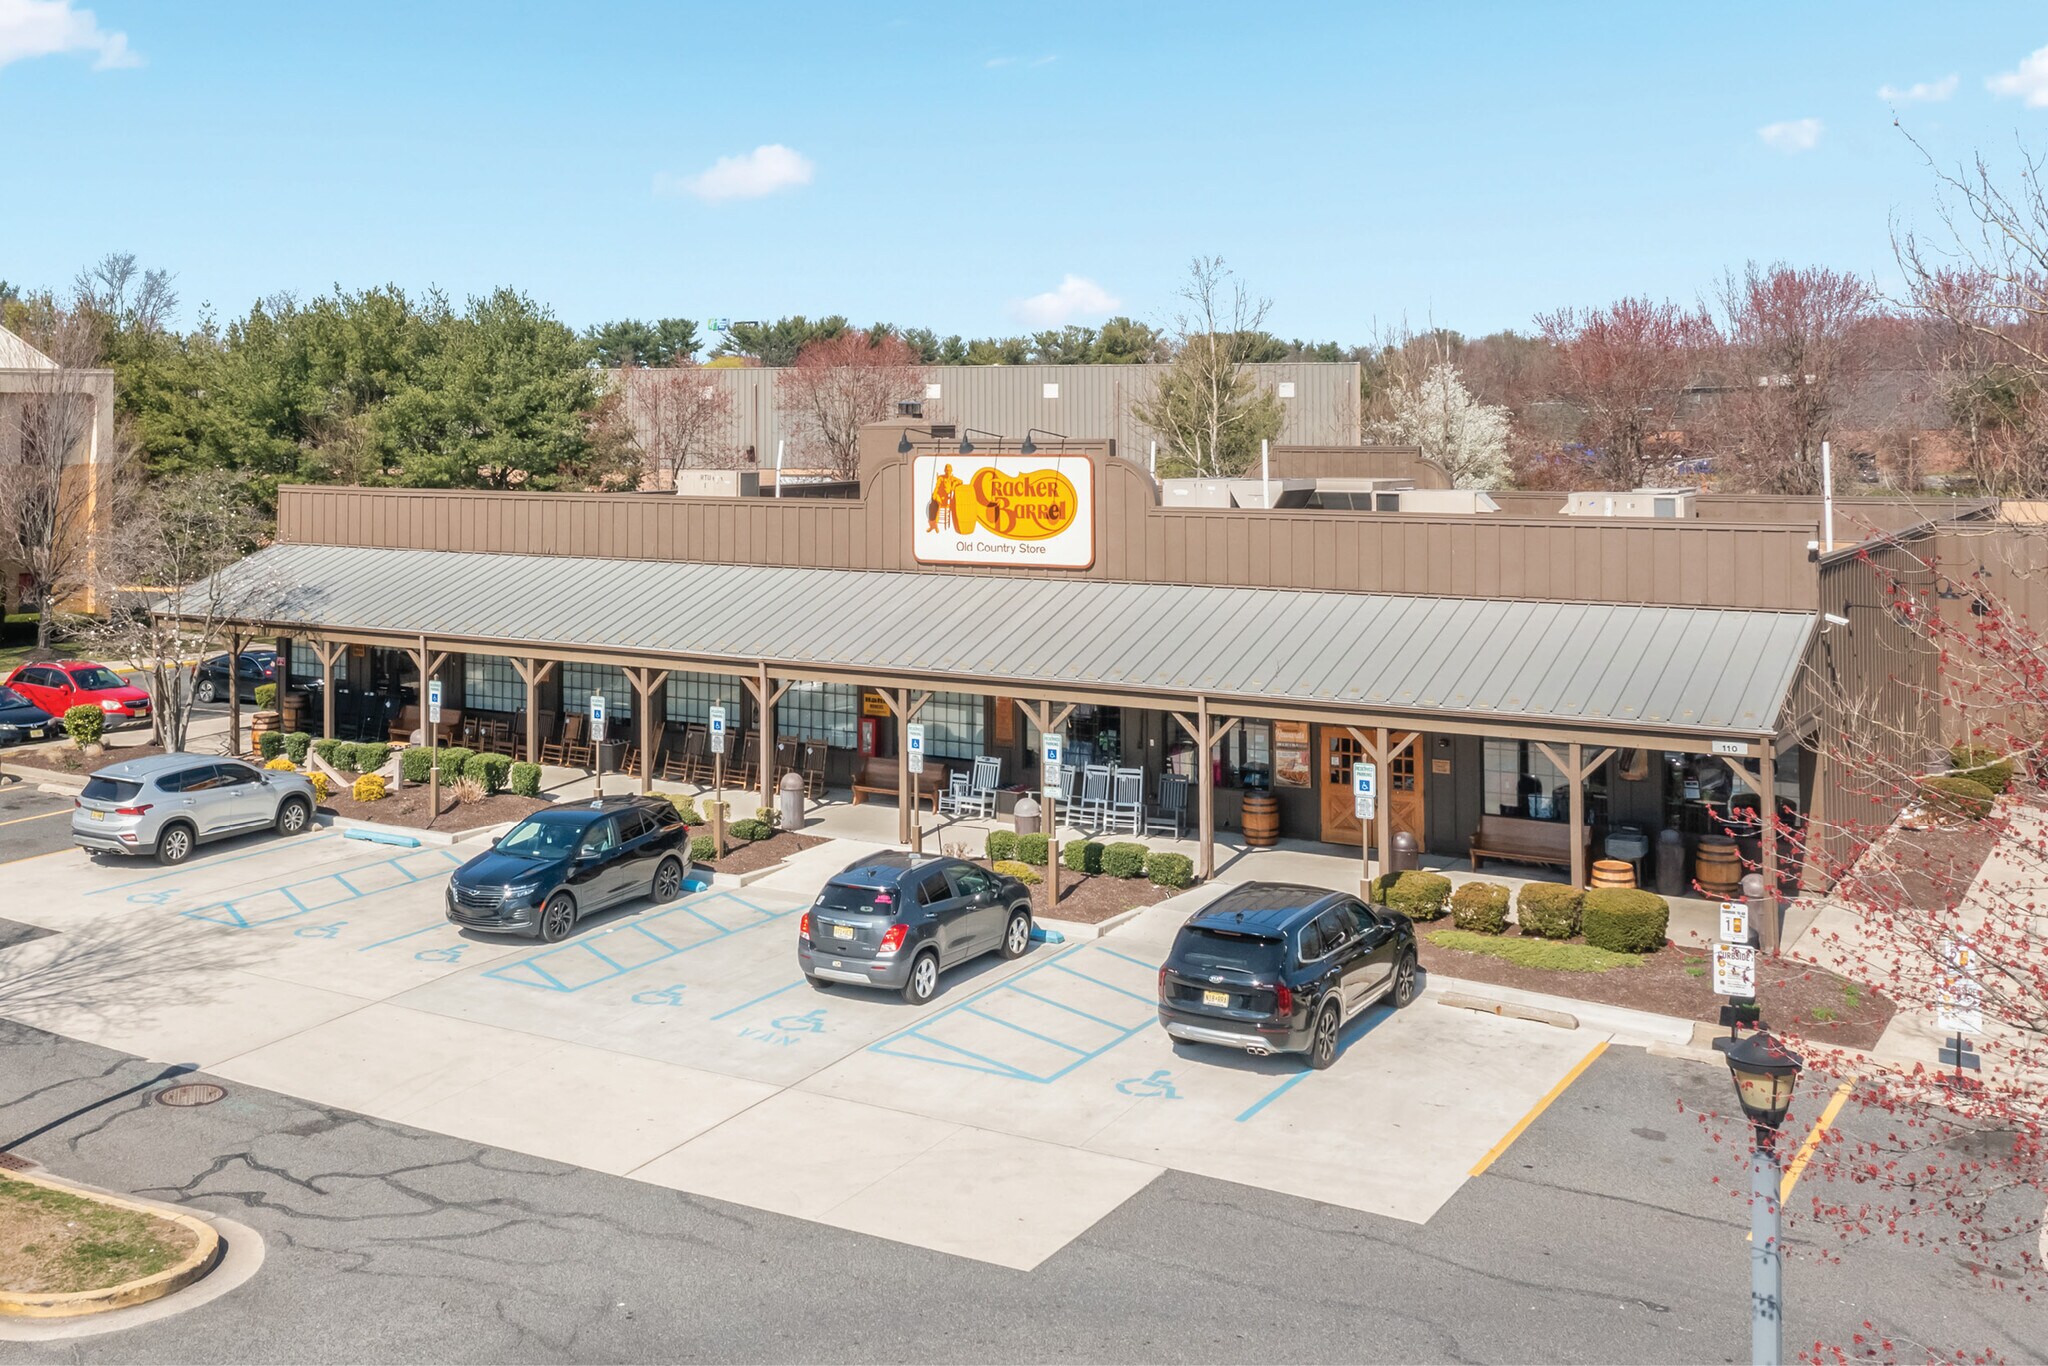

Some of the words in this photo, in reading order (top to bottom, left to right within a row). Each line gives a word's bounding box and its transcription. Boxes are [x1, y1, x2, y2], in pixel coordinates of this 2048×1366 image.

[973, 470, 1059, 507] Cracker
[994, 497, 1066, 534] Barrel
[956, 541, 973, 552] Old
[976, 542, 1016, 555] Country
[1019, 543, 1046, 554] Store
[1725, 919, 1730, 931] 1
